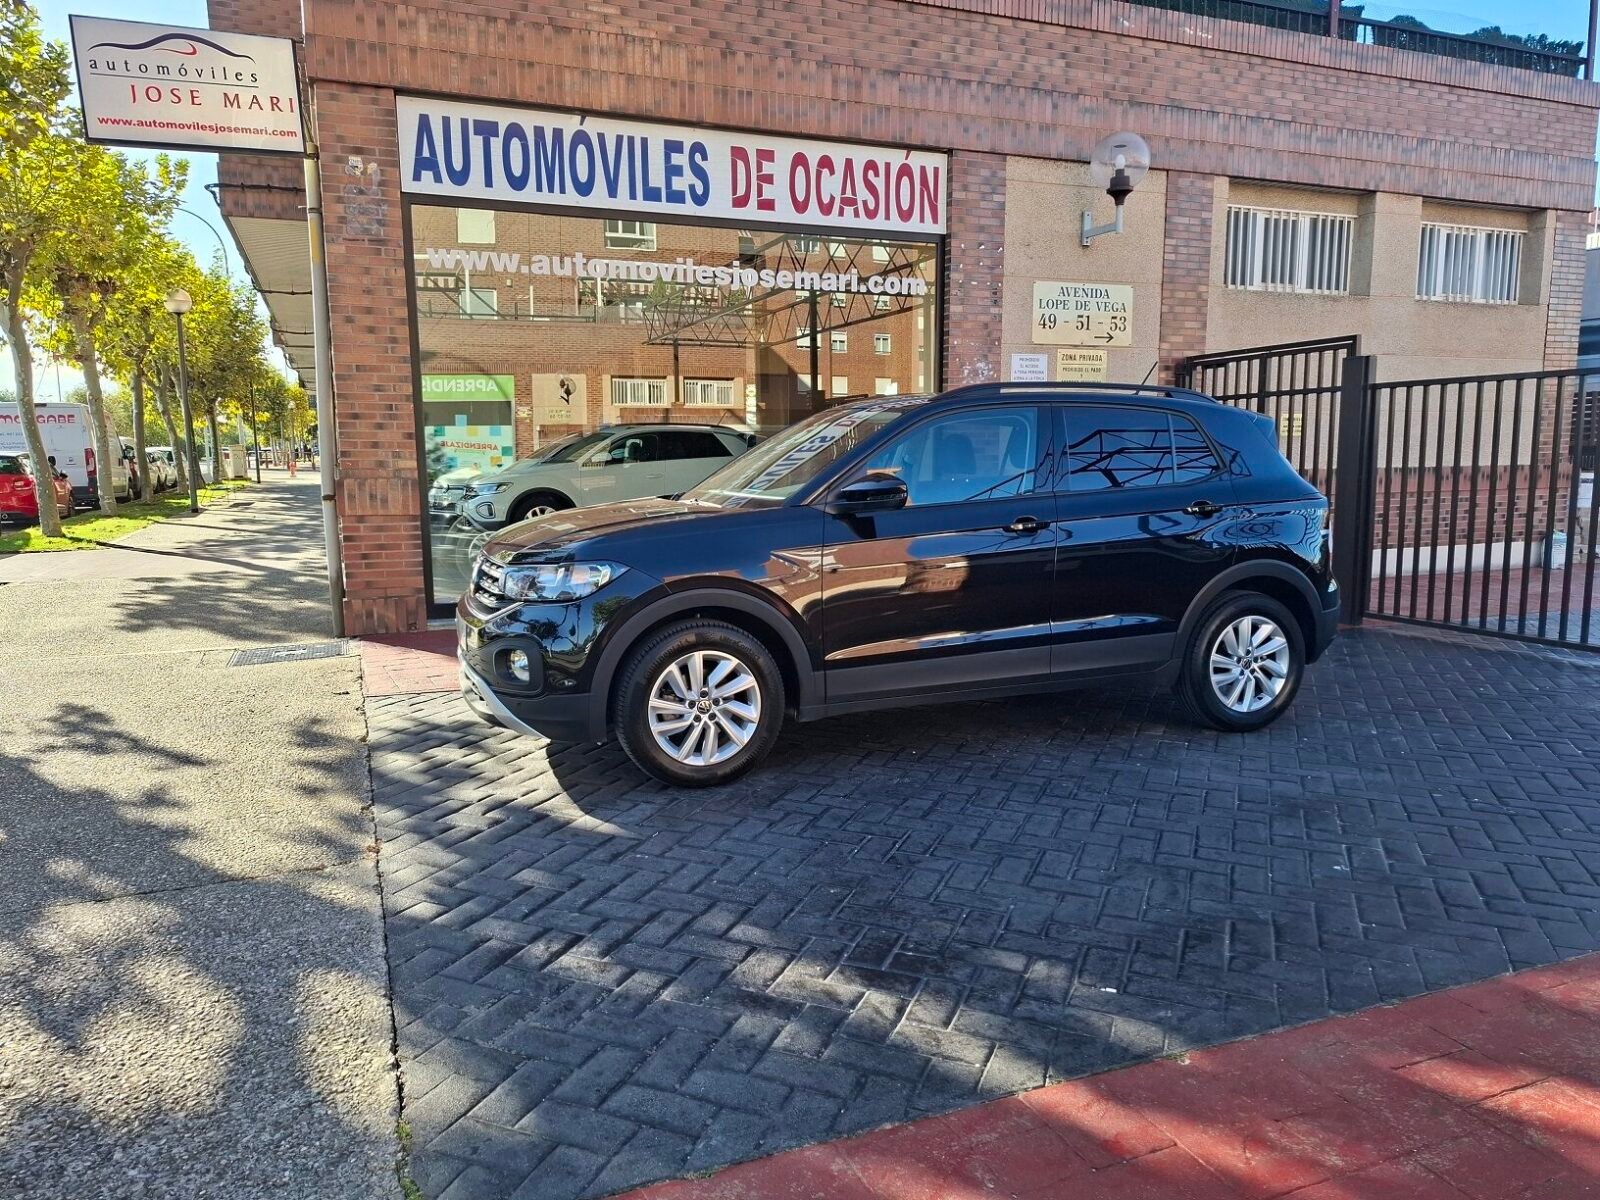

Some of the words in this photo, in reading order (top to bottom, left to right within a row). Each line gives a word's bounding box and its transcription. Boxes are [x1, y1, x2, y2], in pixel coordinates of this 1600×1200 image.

[89, 57, 259, 83] automóviles
[129, 84, 203, 106] JOSE
[223, 92, 295, 114] MARI
[97, 115, 299, 138] www.automovilesjosemari.com
[411, 112, 711, 208] AUTOMÓVILES
[729, 145, 777, 213] DE
[788, 148, 941, 226] OCASIÓN
[425, 245, 928, 297] www.automovilesjosemari.com
[1057, 286, 1111, 300] AVENIDA
[1038, 298, 1070, 311] LOPE
[1075, 300, 1091, 312] DE
[1096, 301, 1127, 313] VEGA
[1038, 313, 1057, 330] 49
[1075, 314, 1091, 331] 51
[1109, 315, 1127, 332] 53
[1061, 353, 1077, 362] ZONA
[1078, 354, 1103, 363] PRIVADA
